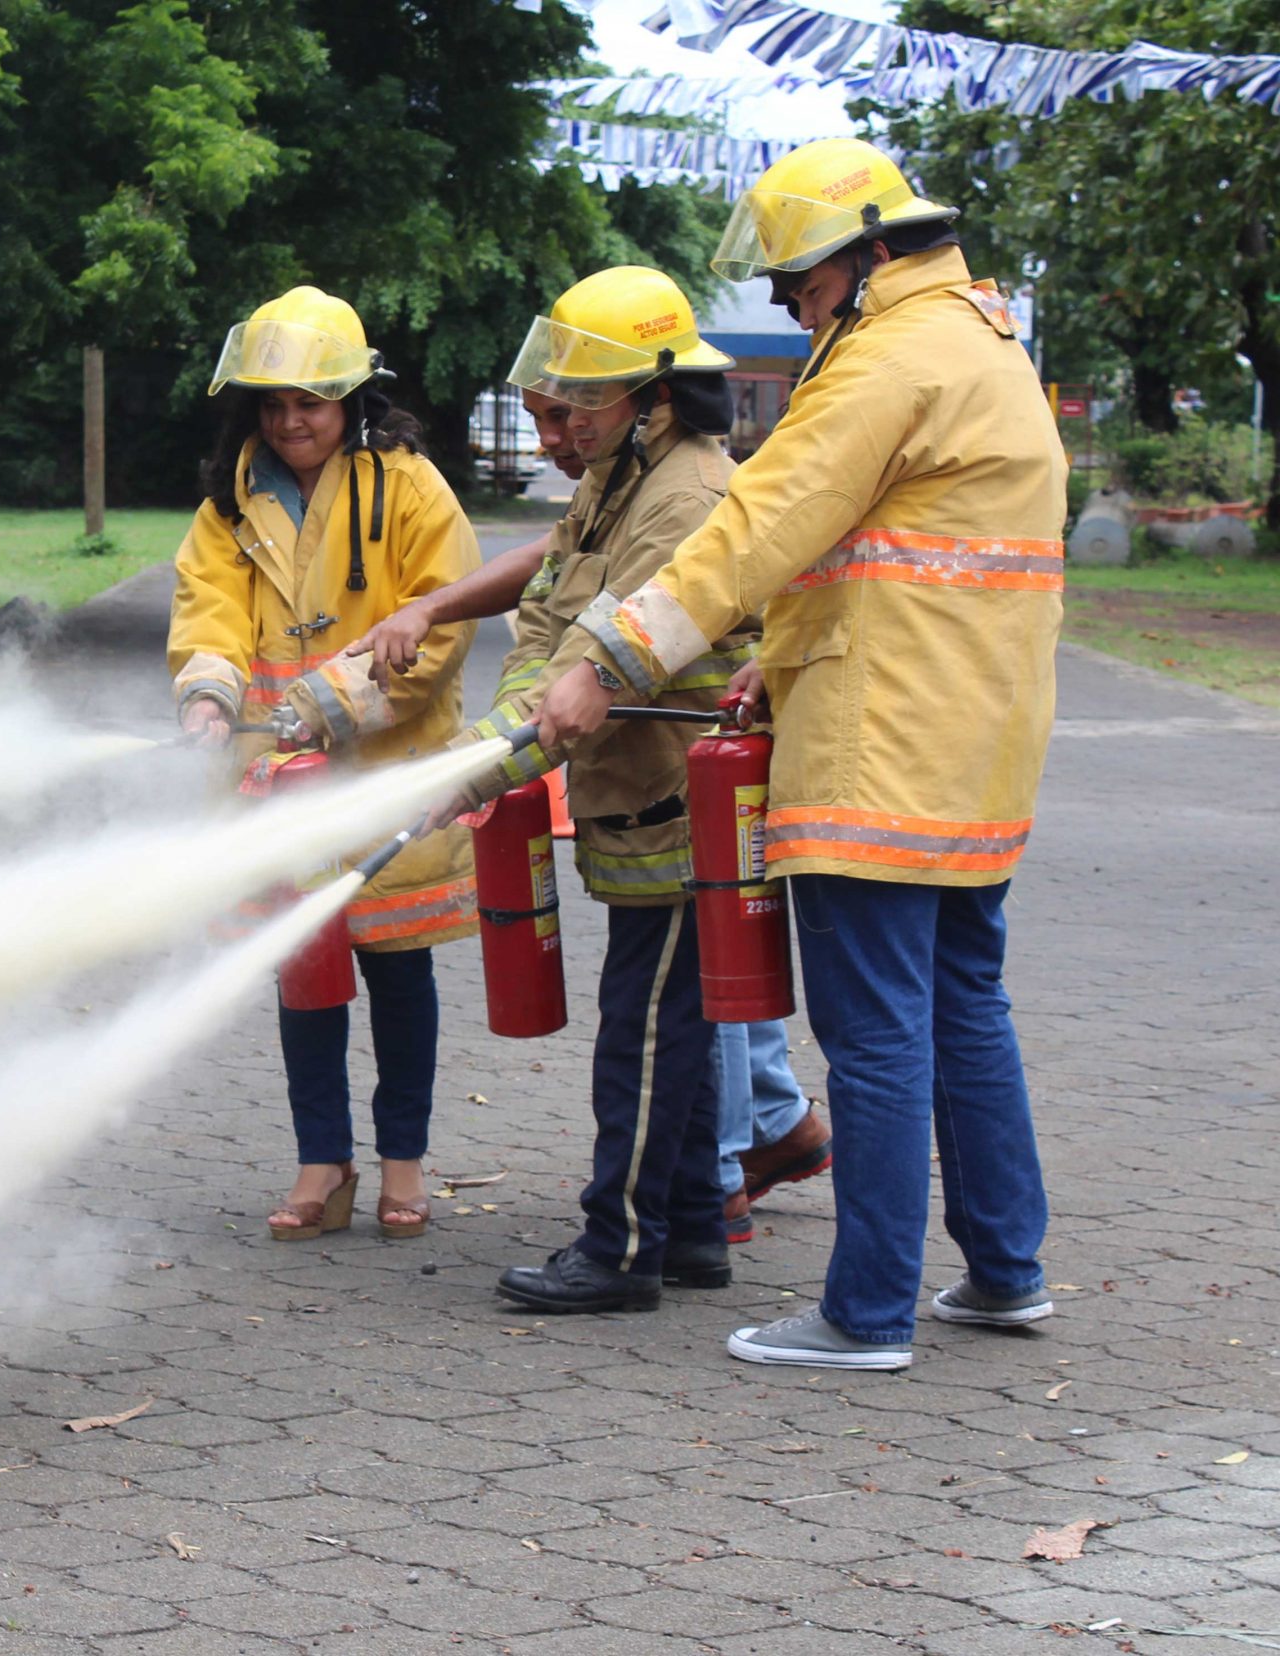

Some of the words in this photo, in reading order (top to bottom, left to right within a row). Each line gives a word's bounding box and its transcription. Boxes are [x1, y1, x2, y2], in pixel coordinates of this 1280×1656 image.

[821, 185, 832, 197] POR
[841, 167, 871, 186] SEGURIDAD
[850, 176, 872, 191] SEGURO
[632, 322, 644, 333] POR
[652, 312, 678, 327] SEGURIDAD
[658, 321, 677, 333] SEGURO
